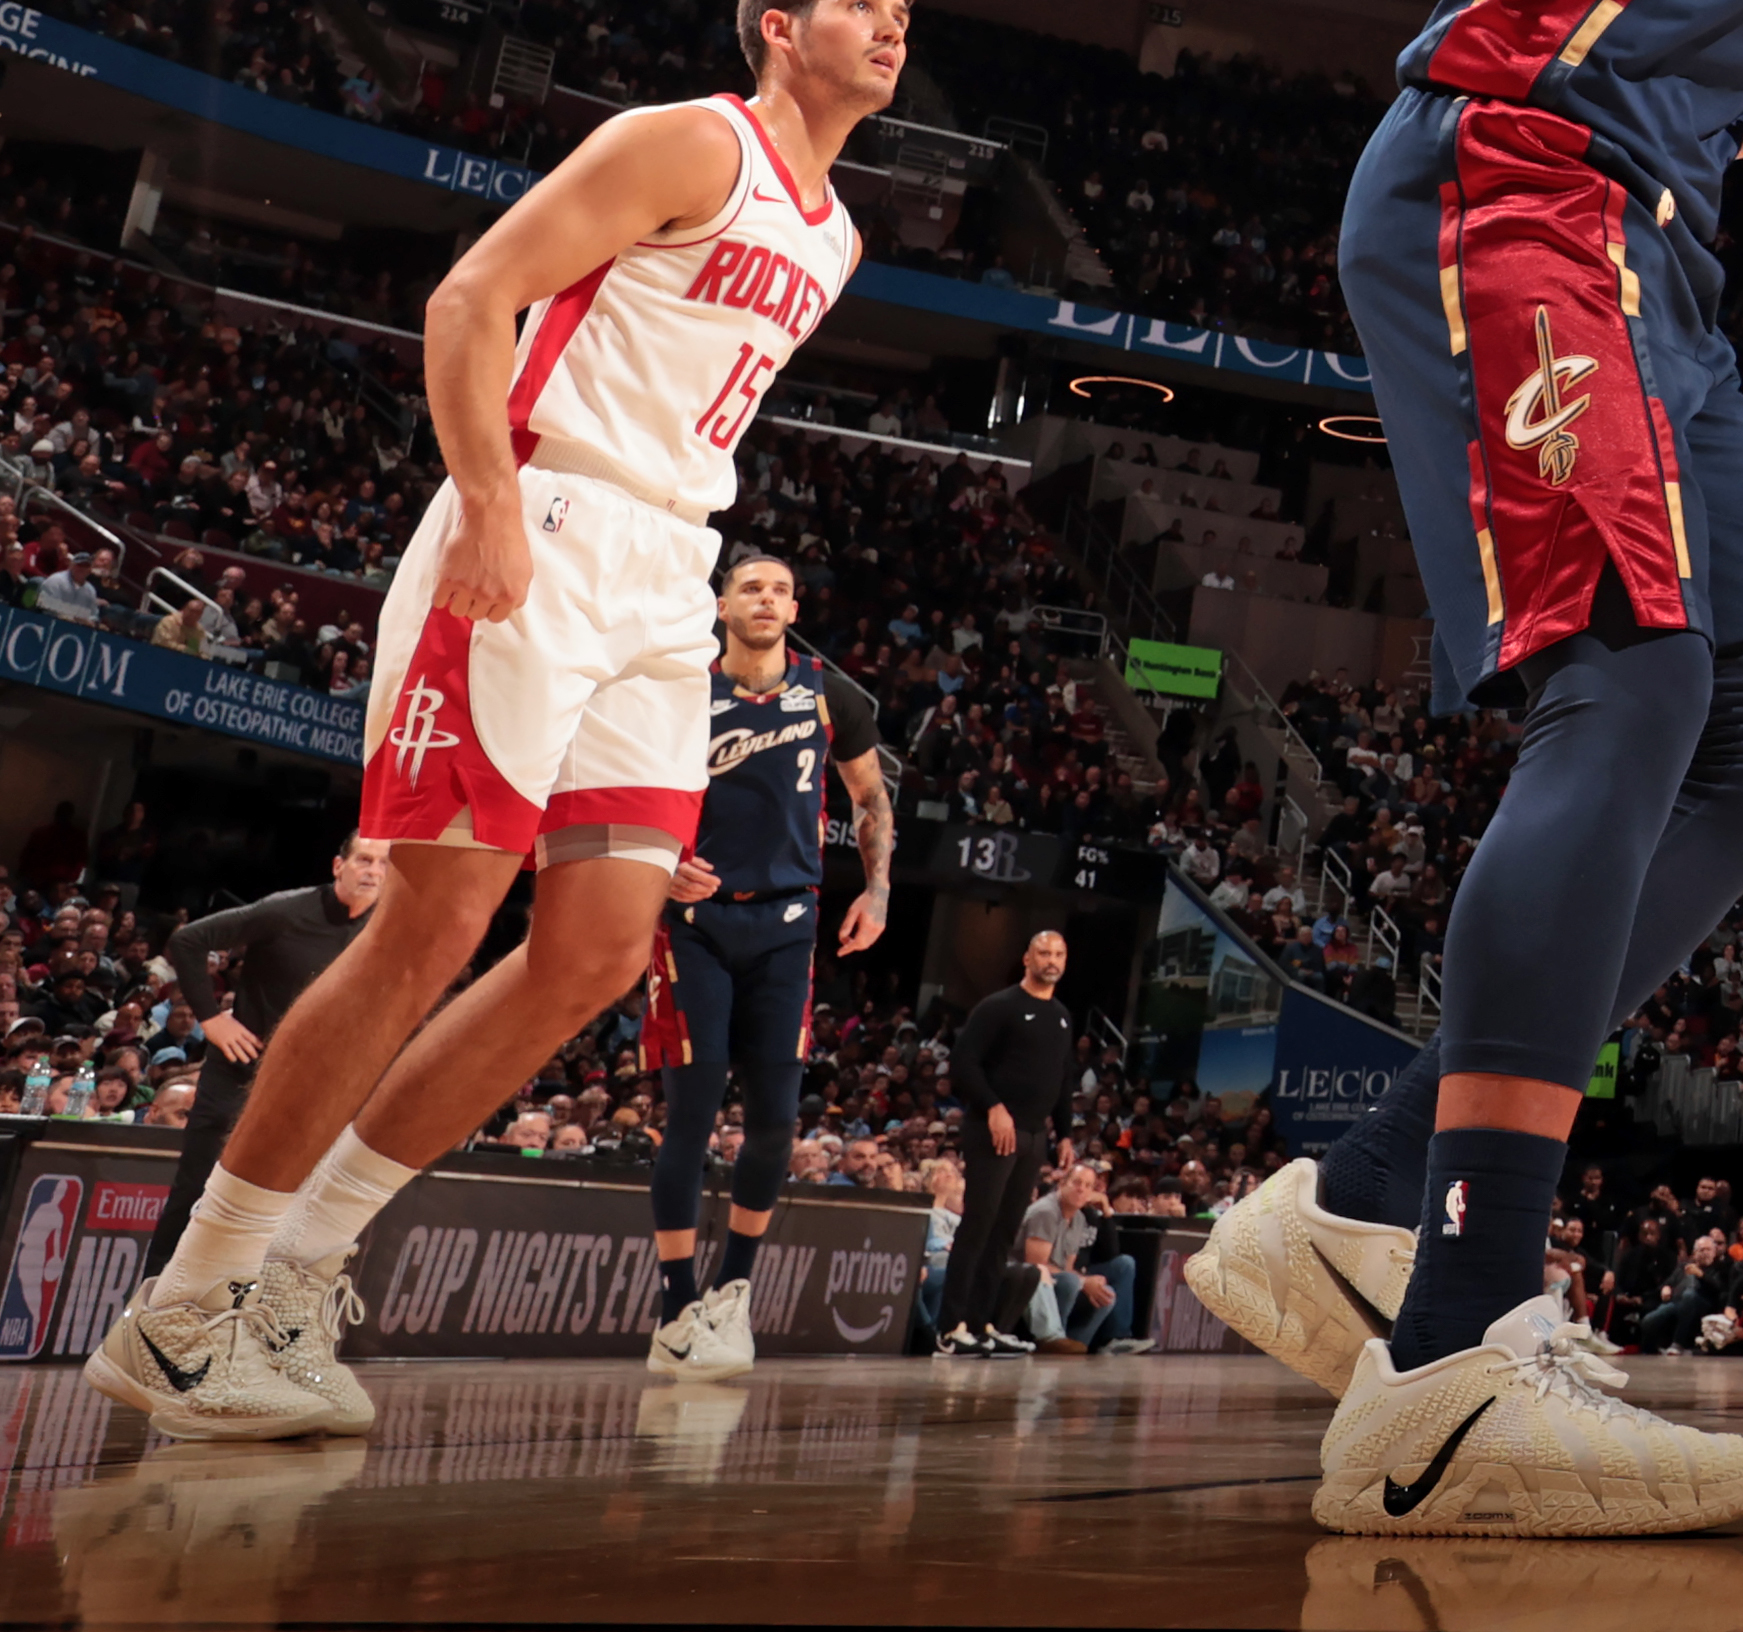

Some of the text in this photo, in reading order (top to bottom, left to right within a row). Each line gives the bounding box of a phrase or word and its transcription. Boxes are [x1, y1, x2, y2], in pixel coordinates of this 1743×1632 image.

[695, 342, 775, 450] 15
[165, 689, 191, 715] OF
[193, 696, 305, 747] OSTEOPATHIC
[205, 668, 361, 732] LAKE ERIE COLLEGE
[796, 748, 816, 792] 2
[957, 836, 995, 871] 13
[1074, 869, 1096, 889] 41
[1077, 845, 1109, 865] FG%
[53, 1236, 153, 1356] NB
[379, 1223, 610, 1335] CUP NIGHTS
[824, 1237, 909, 1305] prime
[1464, 1512, 1514, 1522] ZOOMX
